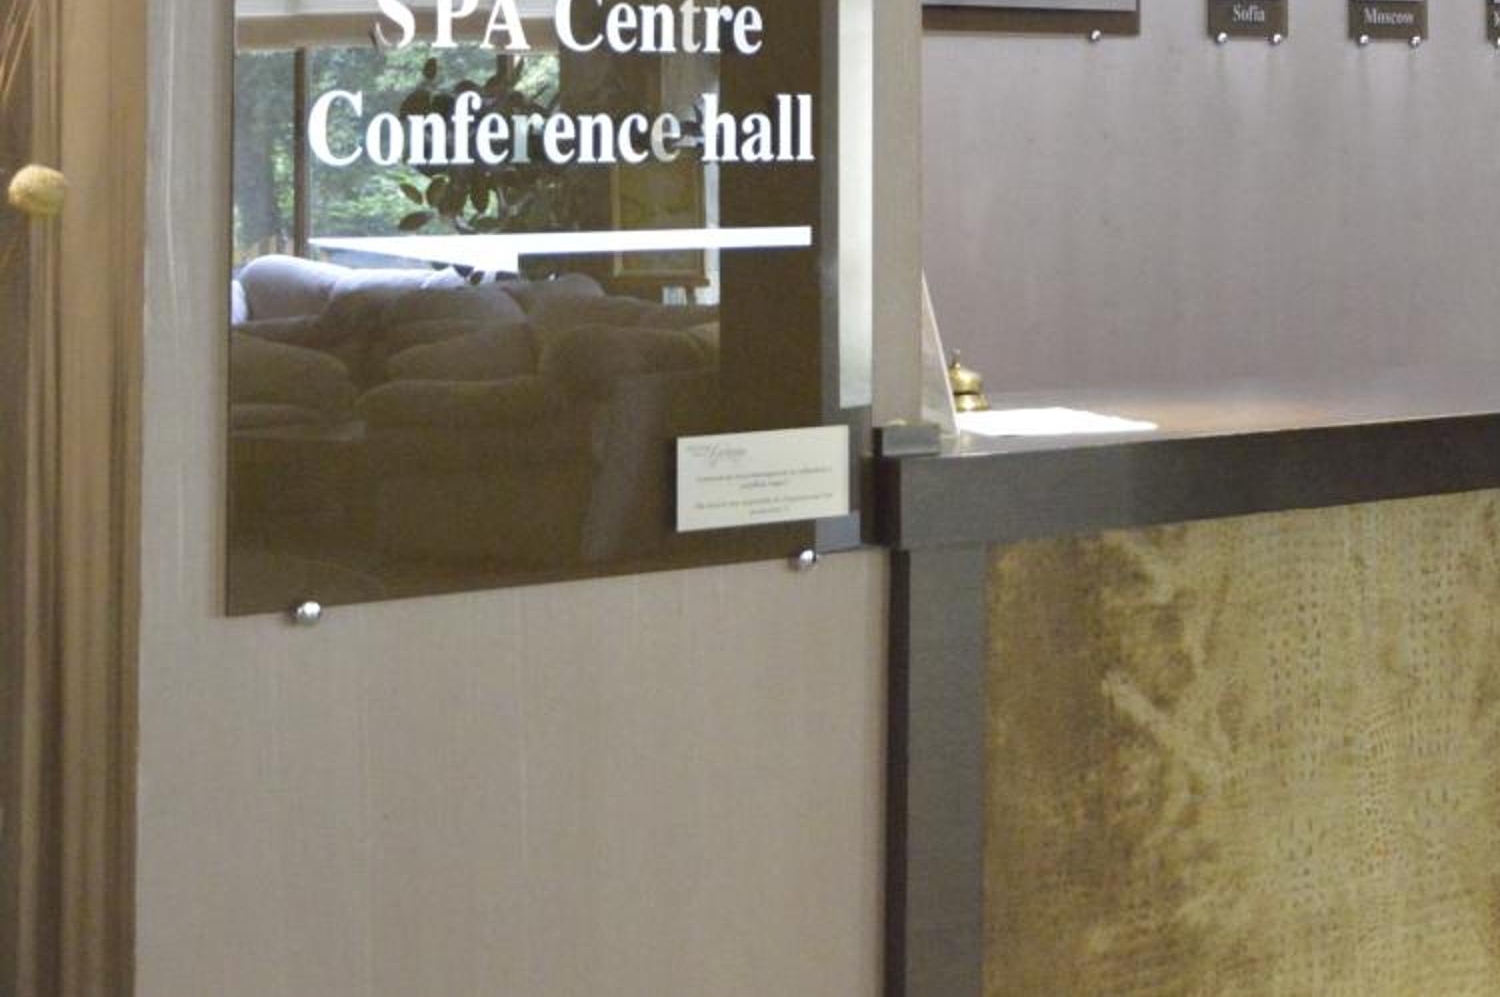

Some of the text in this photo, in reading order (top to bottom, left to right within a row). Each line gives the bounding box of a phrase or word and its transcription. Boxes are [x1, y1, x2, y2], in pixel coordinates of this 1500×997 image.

[1232, 3, 1266, 24] Sofia
[1363, 6, 1414, 25] Moscow
[307, 88, 816, 167] Conference hall
